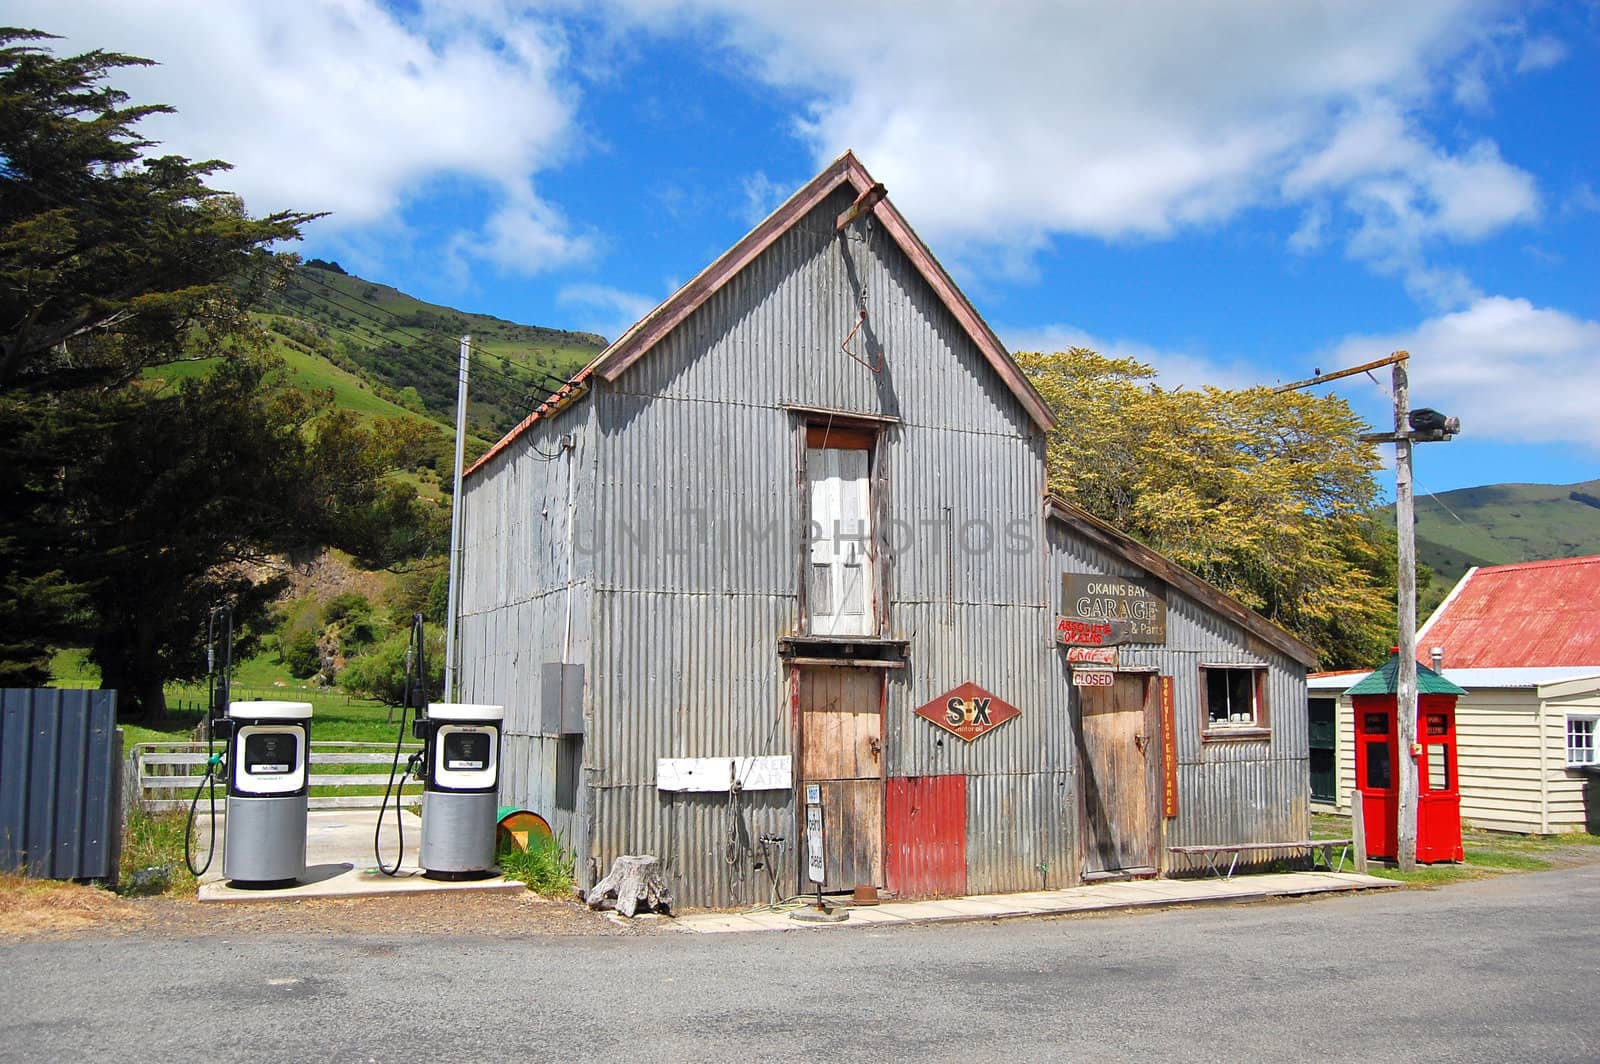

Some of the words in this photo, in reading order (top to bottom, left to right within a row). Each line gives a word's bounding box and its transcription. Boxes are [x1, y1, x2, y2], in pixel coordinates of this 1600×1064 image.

[1087, 583, 1125, 596] OKAINS
[1128, 586, 1146, 597] BAY
[1077, 597, 1156, 619] GARAGE
[1057, 619, 1112, 635] ABSOLUTE
[1131, 623, 1138, 634] &
[1064, 631, 1102, 643] OKAINS
[1074, 674, 1112, 685] CLOSED
